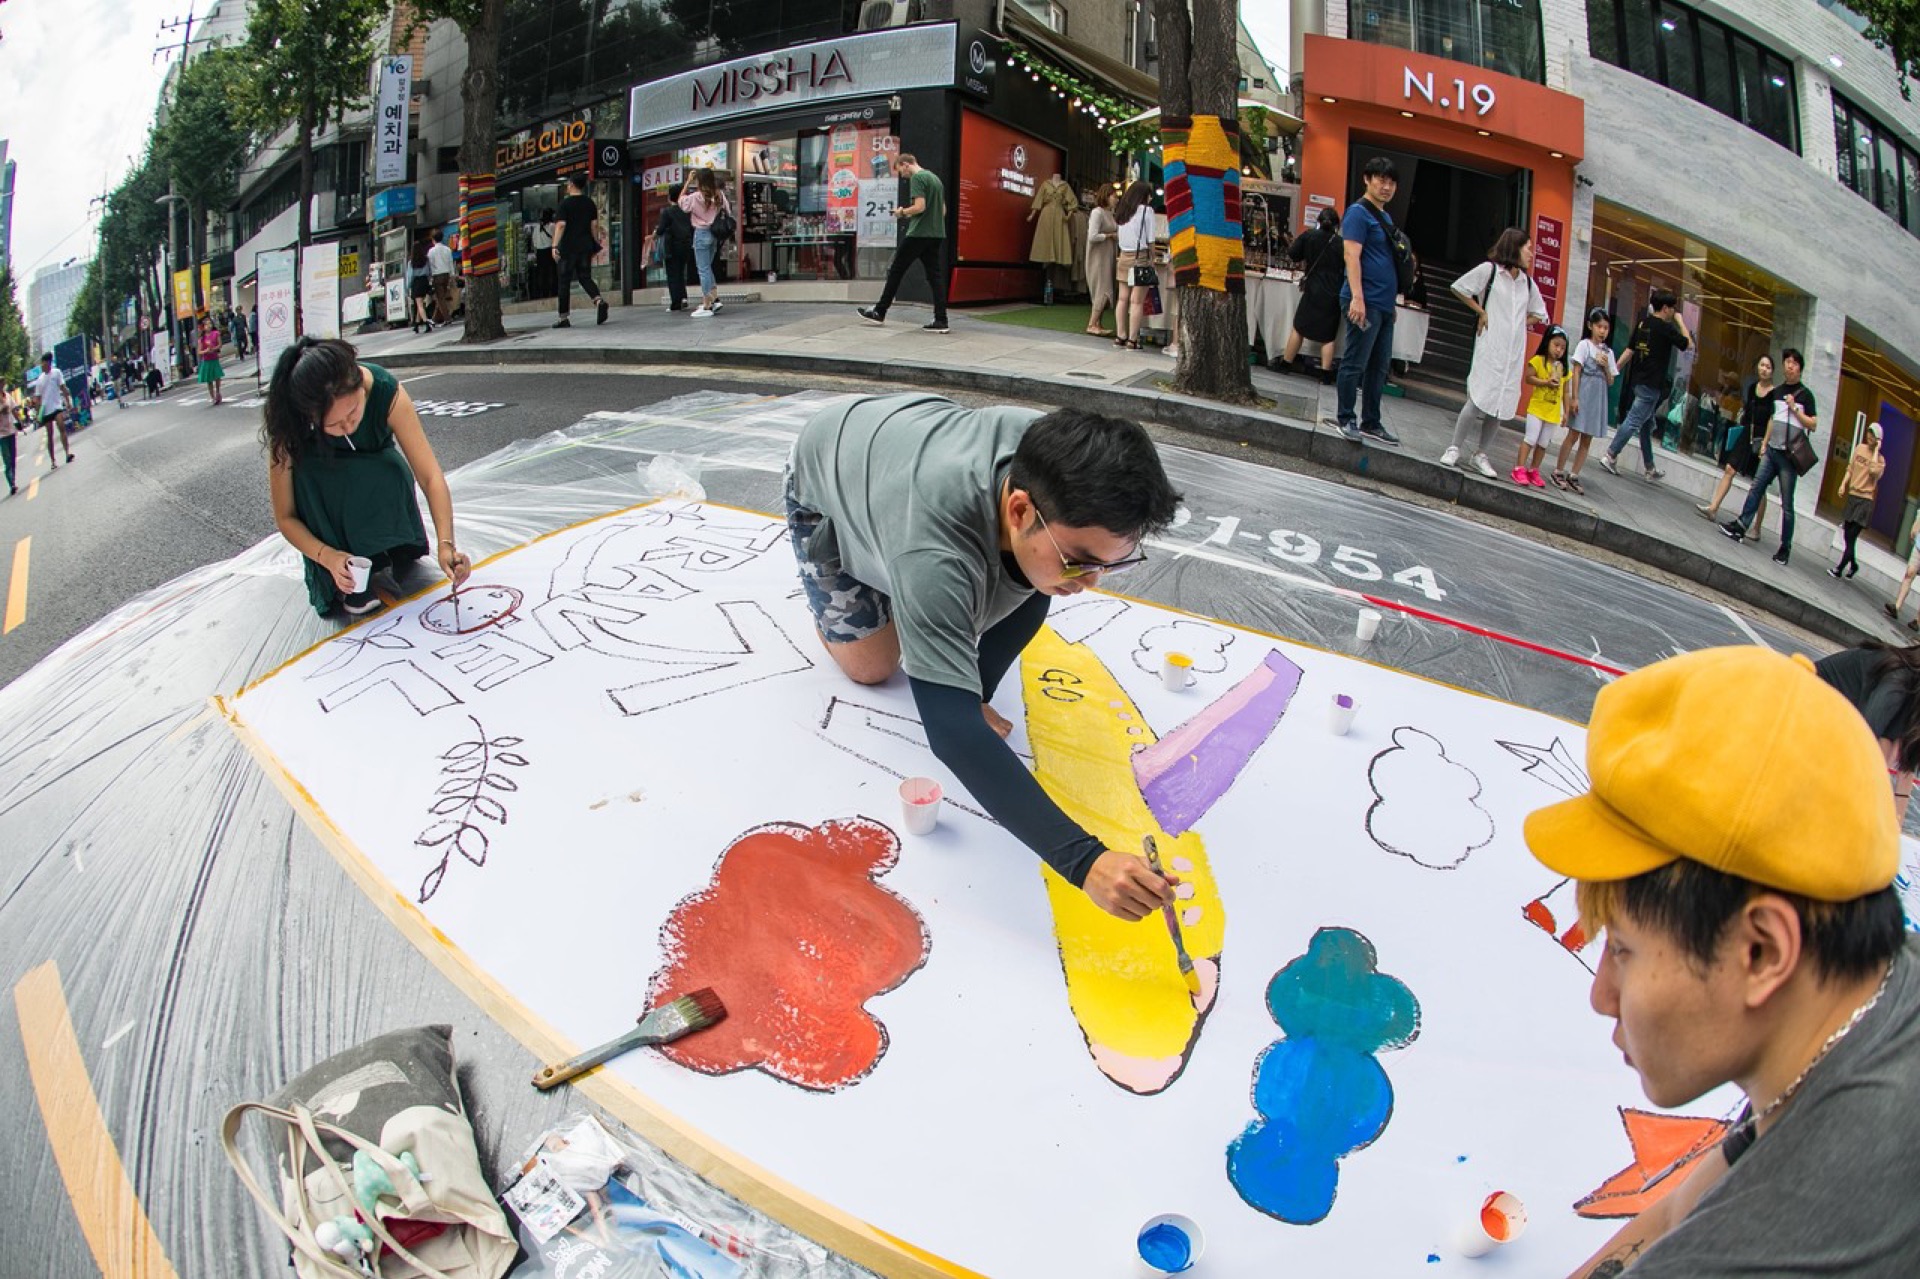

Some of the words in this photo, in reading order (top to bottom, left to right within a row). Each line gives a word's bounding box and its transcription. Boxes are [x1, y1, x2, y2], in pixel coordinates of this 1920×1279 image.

[691, 49, 853, 111] MISSHA
[1403, 65, 1496, 116] N.19
[383, 104, 403, 155] 예치과
[496, 137, 537, 169] CLUB
[537, 119, 587, 153] CLIO
[644, 167, 680, 188] SALE
[865, 200, 895, 217] 2+1
